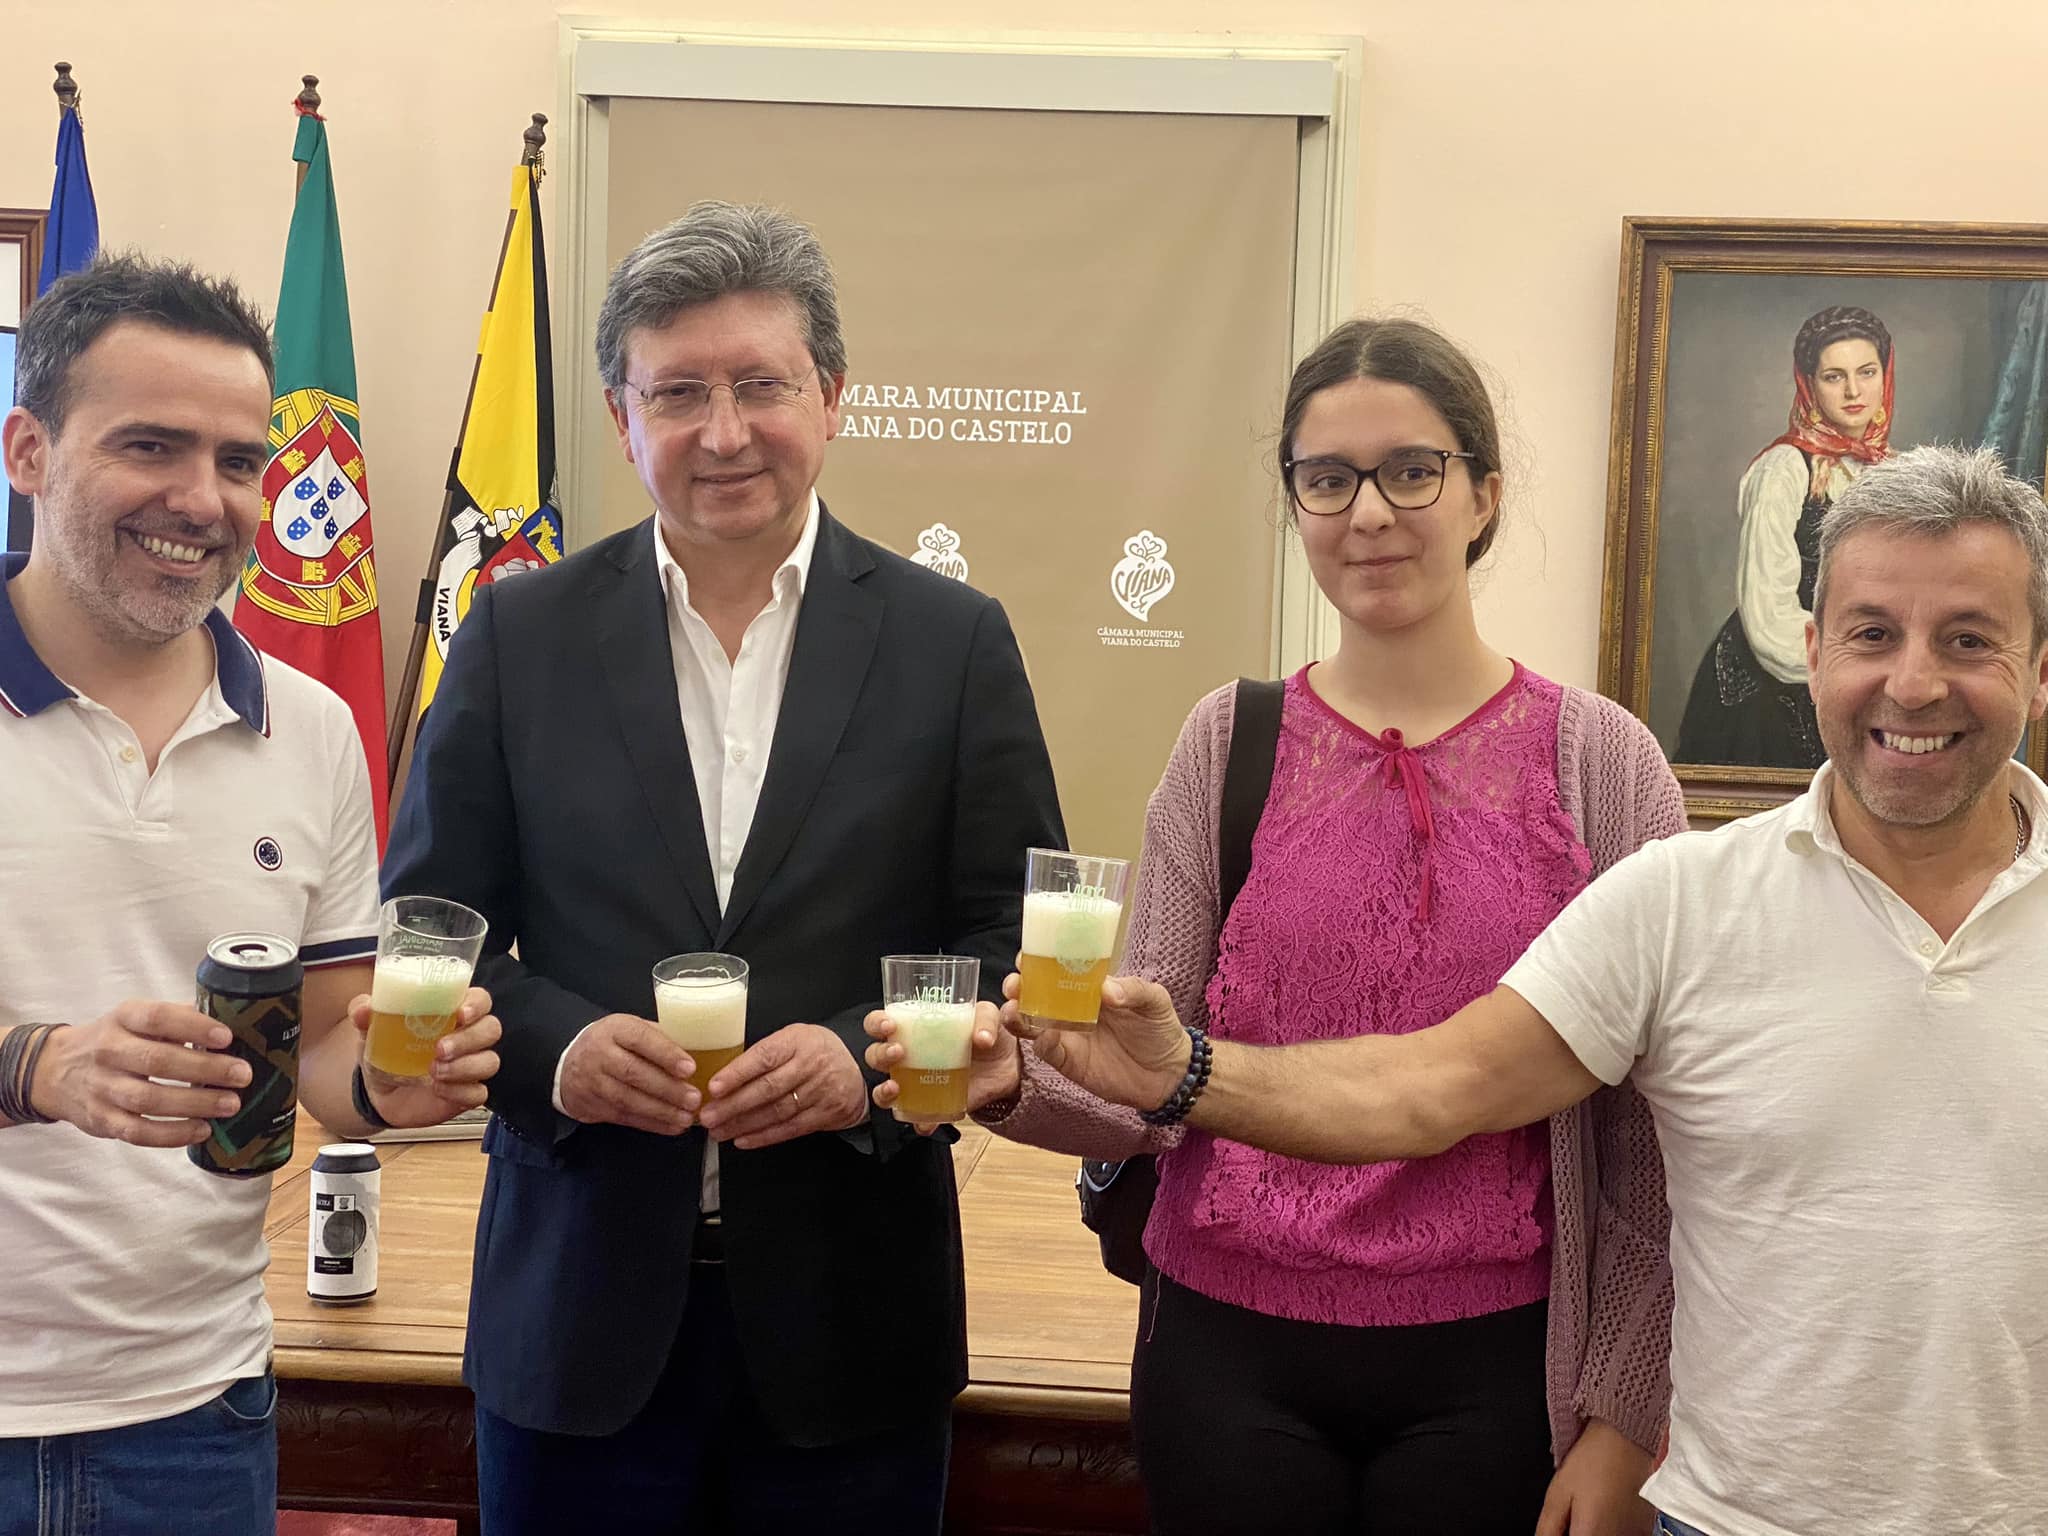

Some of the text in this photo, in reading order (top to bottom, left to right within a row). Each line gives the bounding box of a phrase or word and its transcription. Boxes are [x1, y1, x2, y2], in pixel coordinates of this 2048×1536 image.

[839, 384, 1087, 414] MARA MUNICIPAL
[835, 414, 1072, 445] ANA DO CASTELO
[1114, 562, 1172, 602] VIANA
[437, 587, 451, 642] VIANA
[1096, 626, 1185, 639] CÂMARA MUNICIPAL
[1100, 636, 1181, 649] VIANA DO CASTELO
